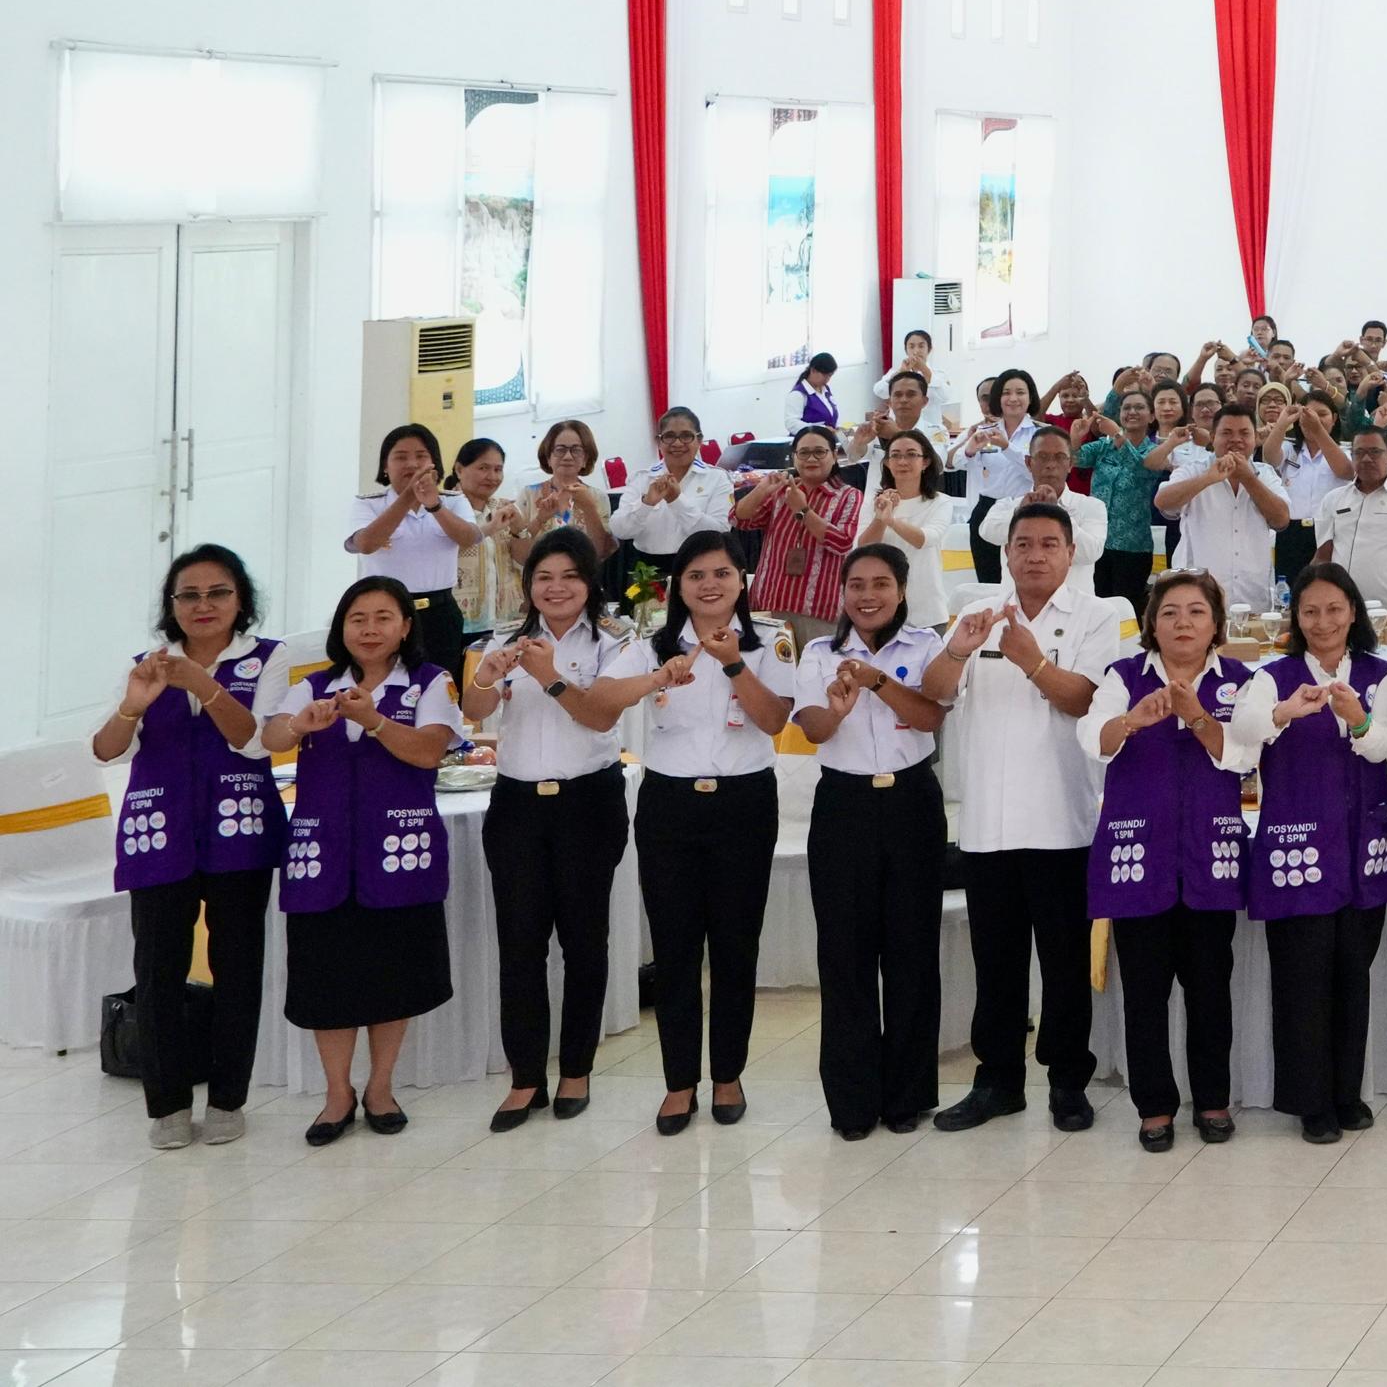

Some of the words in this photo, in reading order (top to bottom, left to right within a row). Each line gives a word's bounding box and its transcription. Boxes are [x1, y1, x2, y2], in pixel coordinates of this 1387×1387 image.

[387, 808, 433, 818] POSYANDU
[407, 818, 424, 826] SPM
[1108, 819, 1145, 830] POSYANDU
[1226, 826, 1242, 834] SPM
[1268, 823, 1317, 834] POSYANDU
[1120, 830, 1134, 839] SPM
[1287, 834, 1307, 842] SPM
